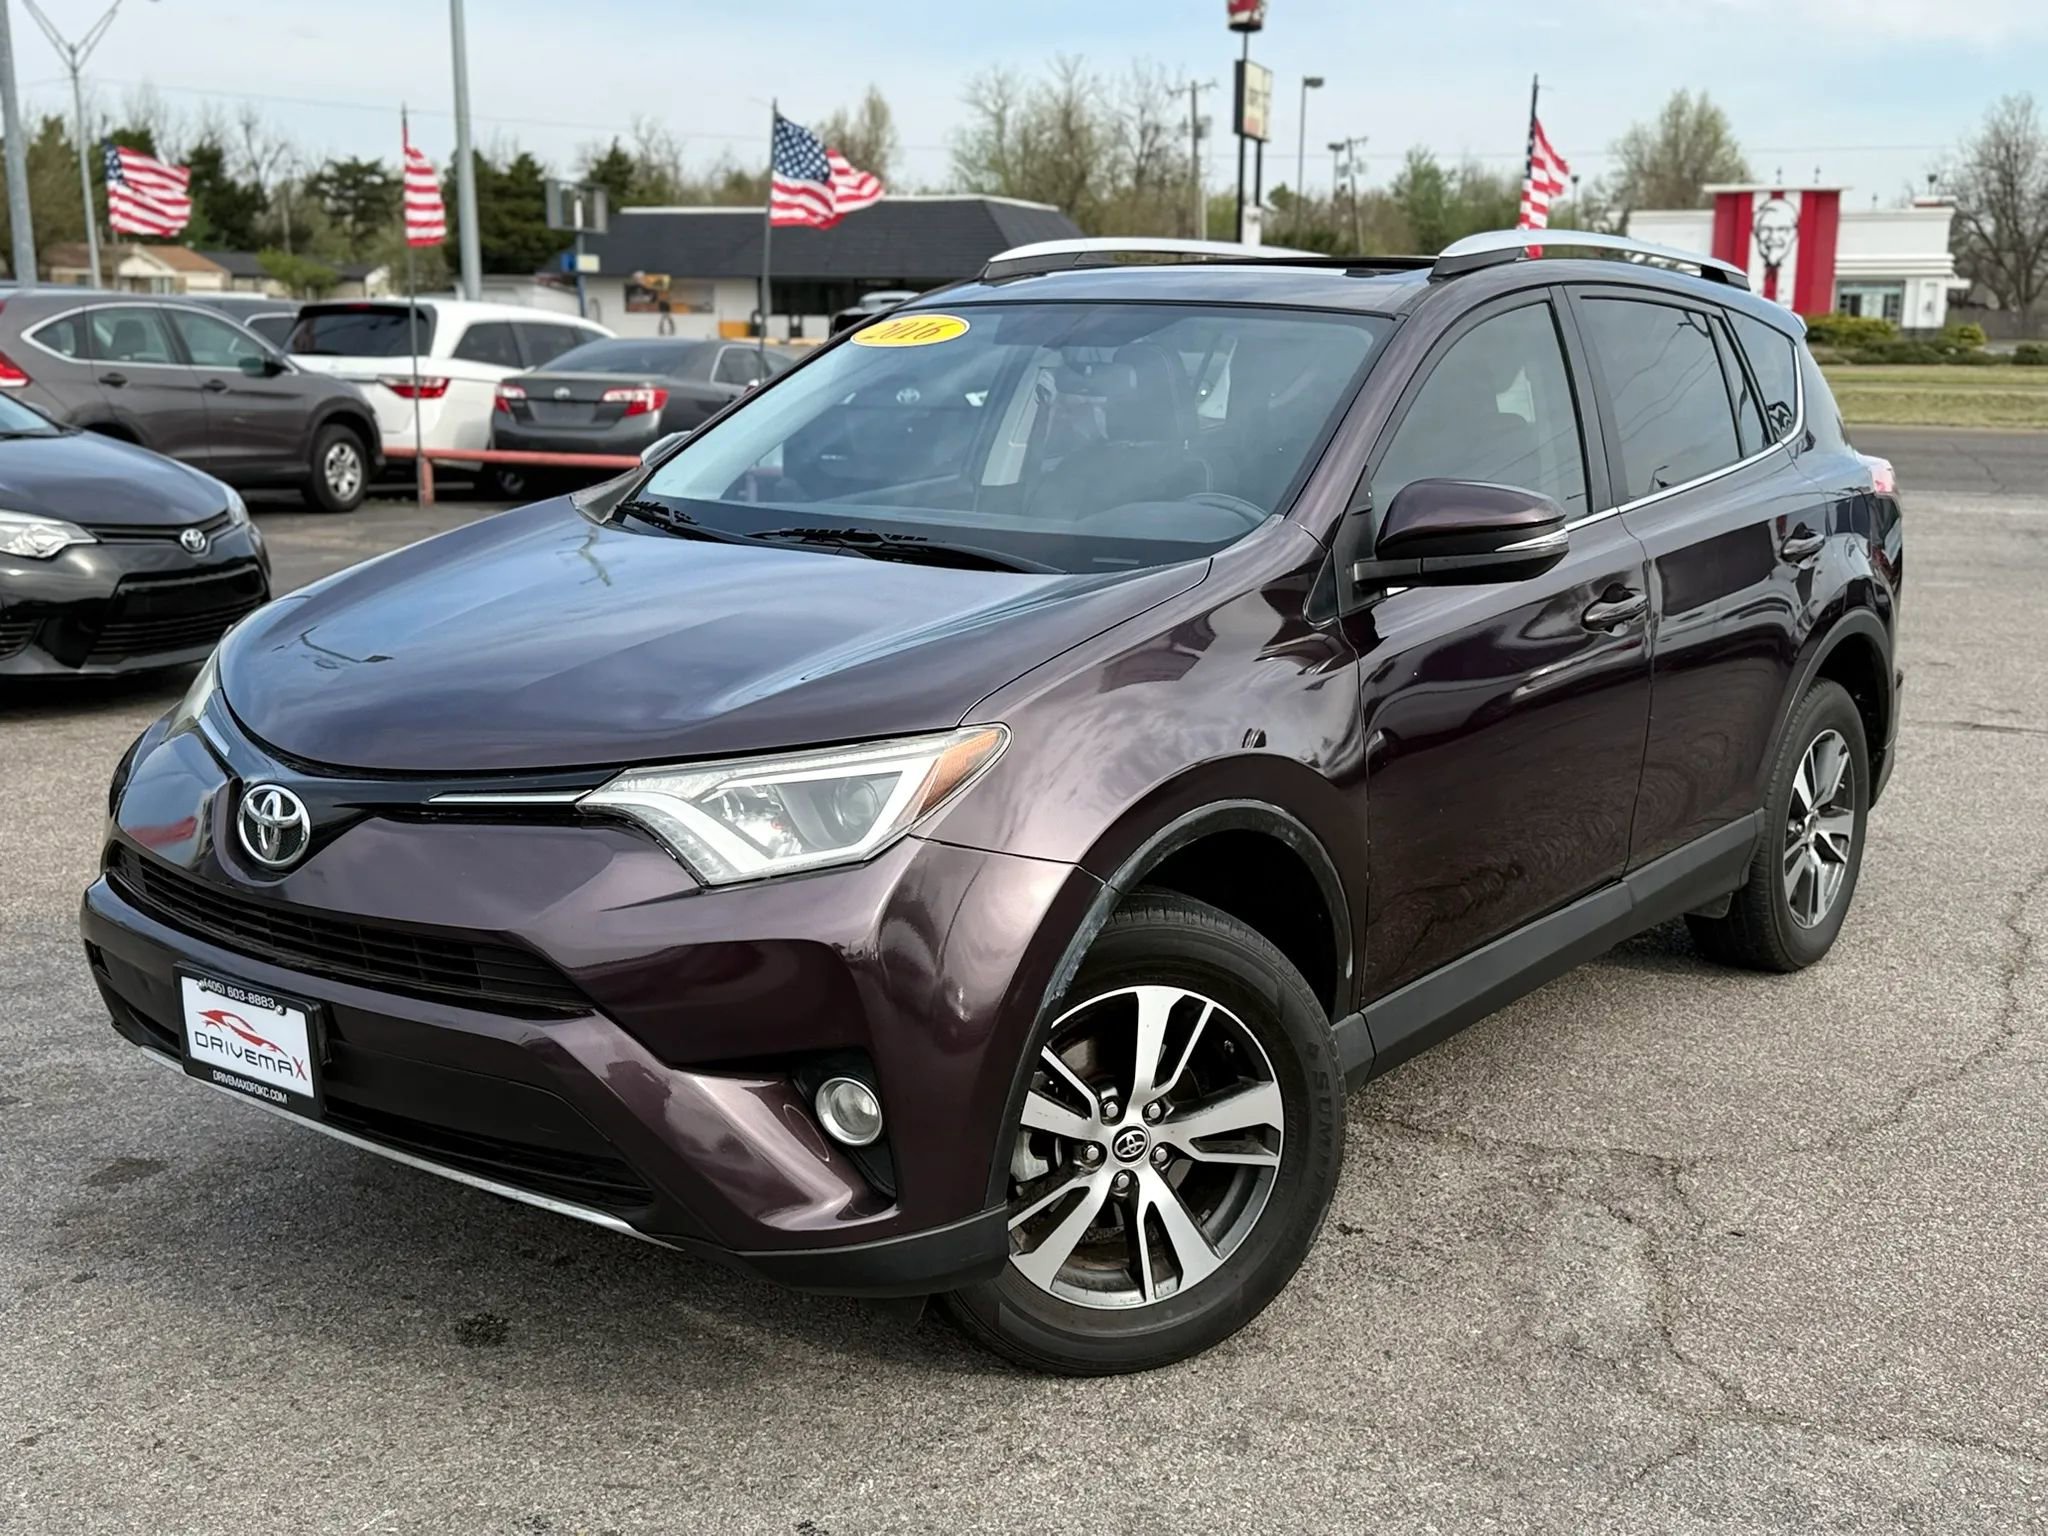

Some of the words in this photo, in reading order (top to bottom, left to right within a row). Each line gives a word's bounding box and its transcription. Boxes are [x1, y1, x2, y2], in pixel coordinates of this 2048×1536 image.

[863, 321, 958, 341] 2016
[227, 986, 275, 1009] 603-8883
[194, 1031, 307, 1081] DRIVEMAX
[212, 1069, 288, 1104] DRIVEMAXOFOKC.COM
